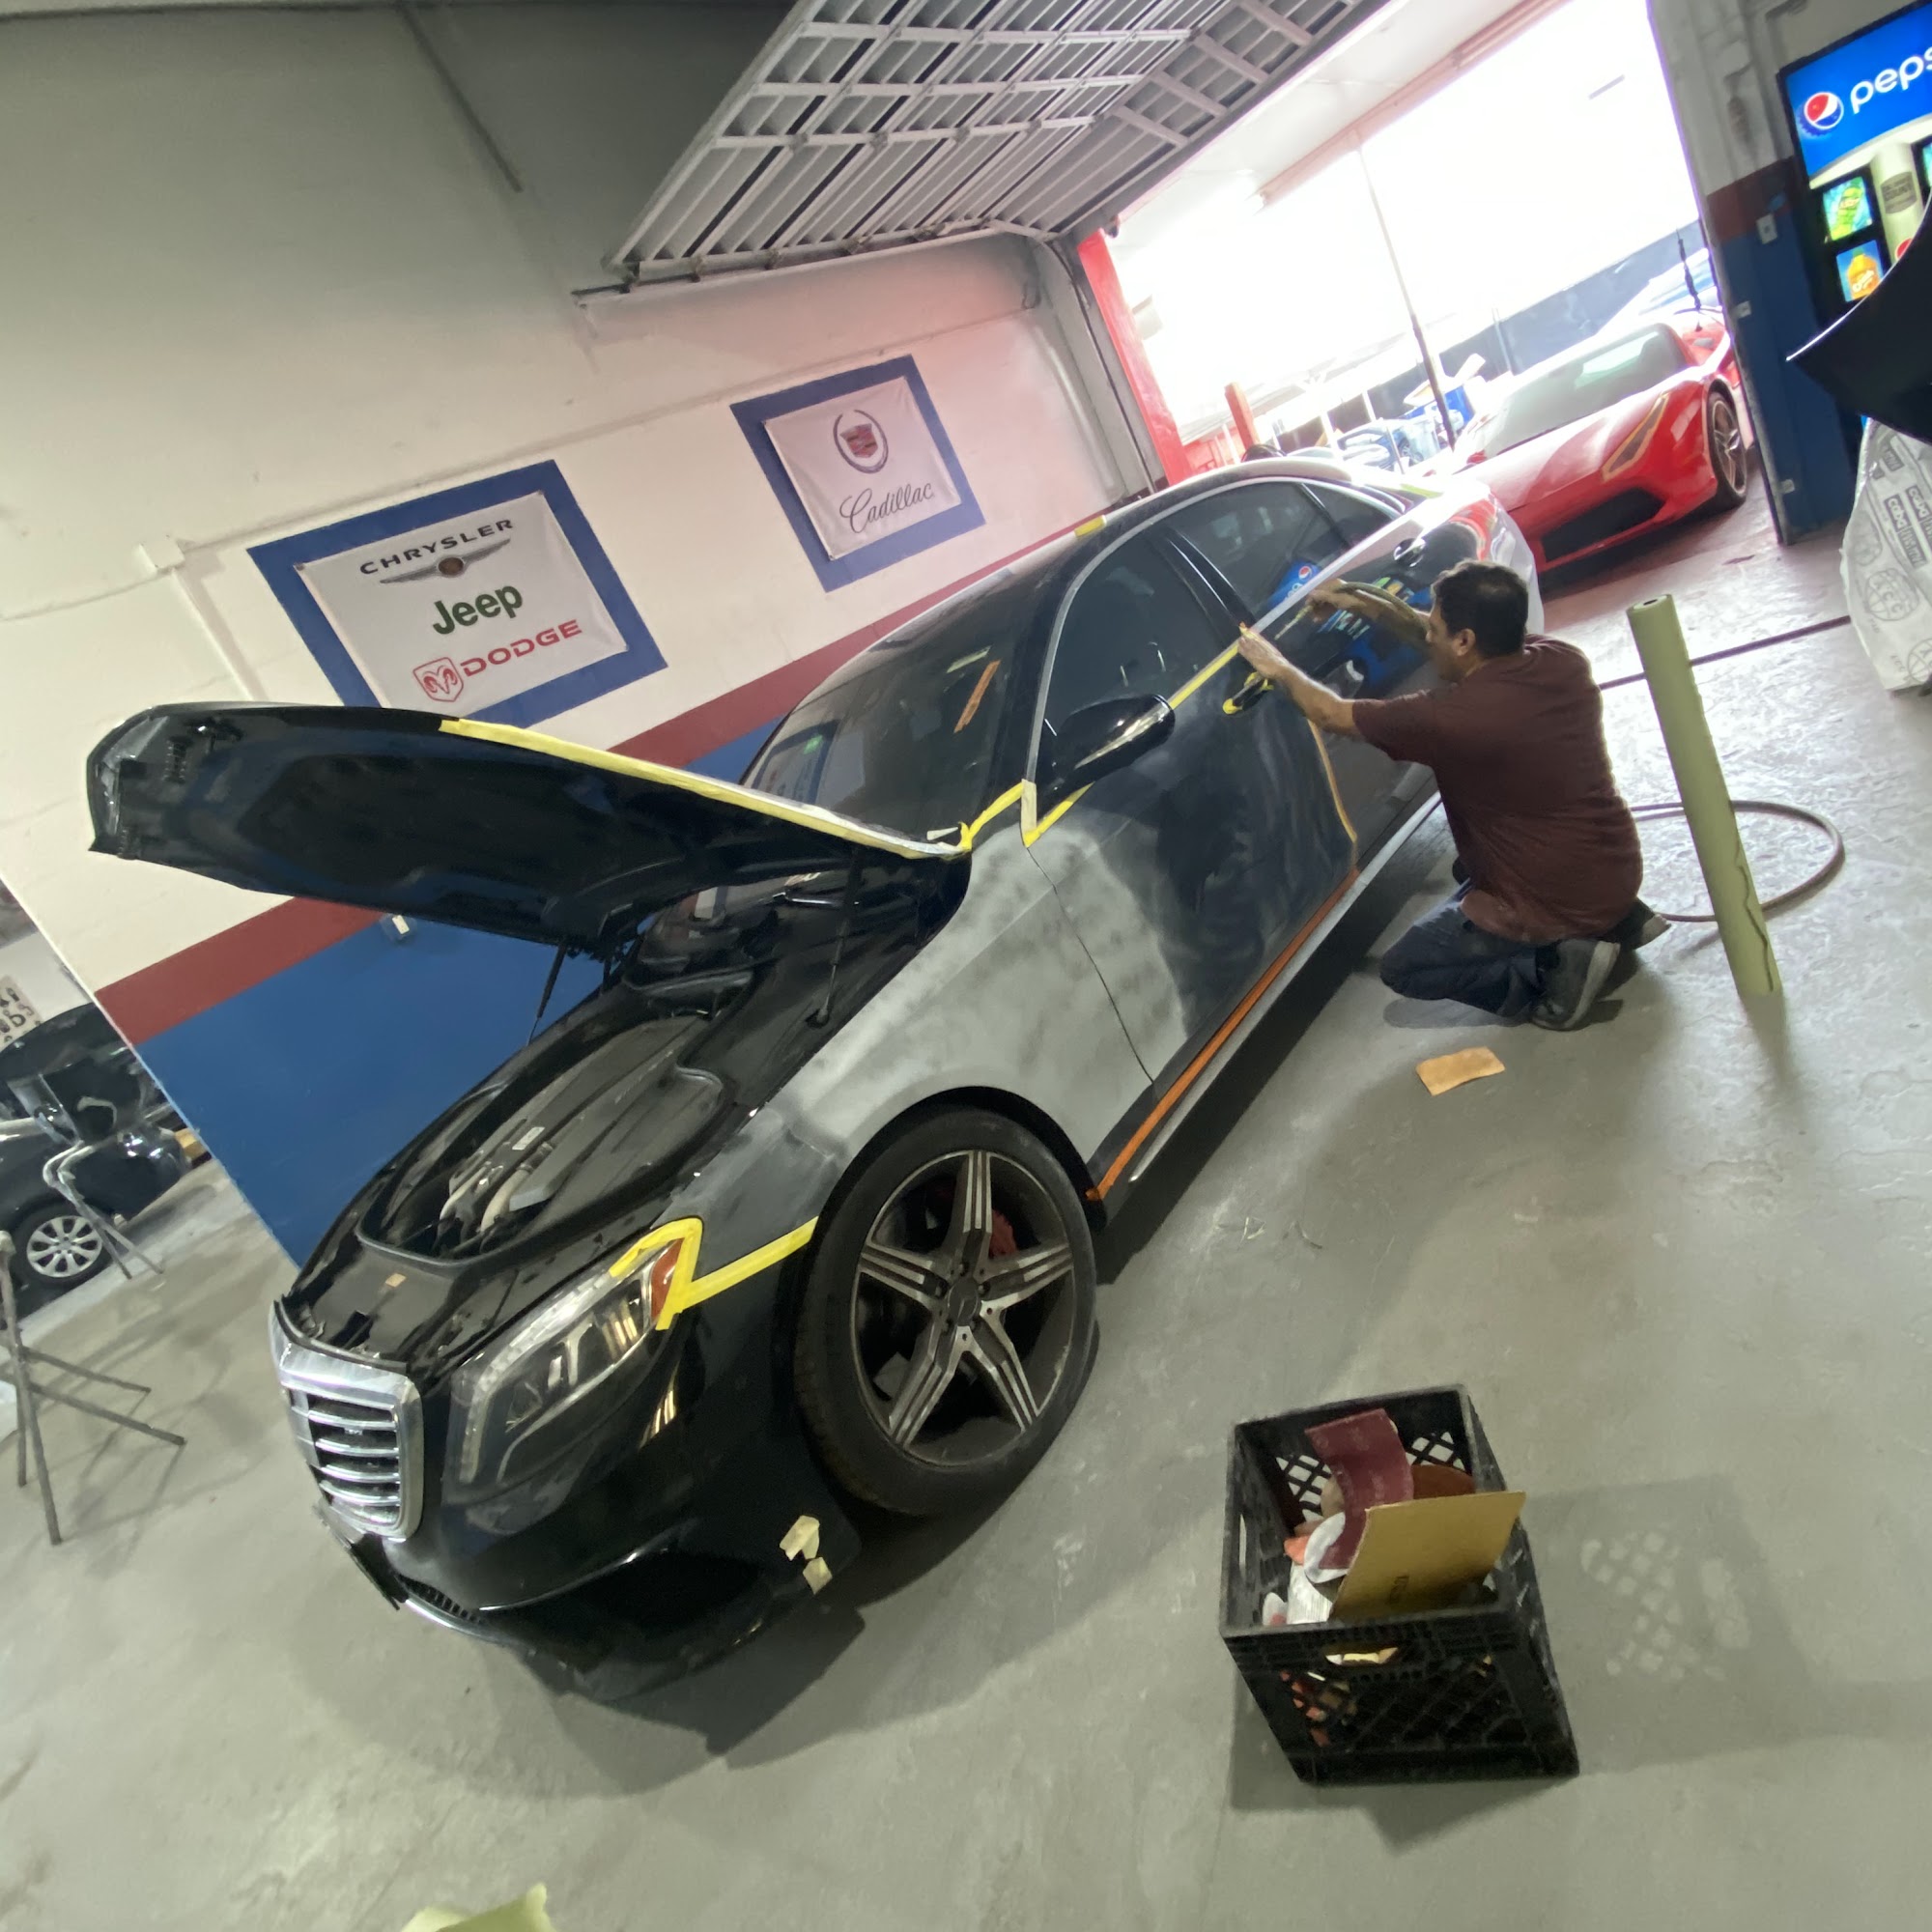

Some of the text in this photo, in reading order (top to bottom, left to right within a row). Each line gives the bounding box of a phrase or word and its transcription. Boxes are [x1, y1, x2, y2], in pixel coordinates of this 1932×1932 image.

[839, 483, 934, 533] Cadillac
[359, 519, 514, 575] CHRYSLER
[432, 585, 523, 635] Jeep
[460, 619, 582, 677] DODGE
